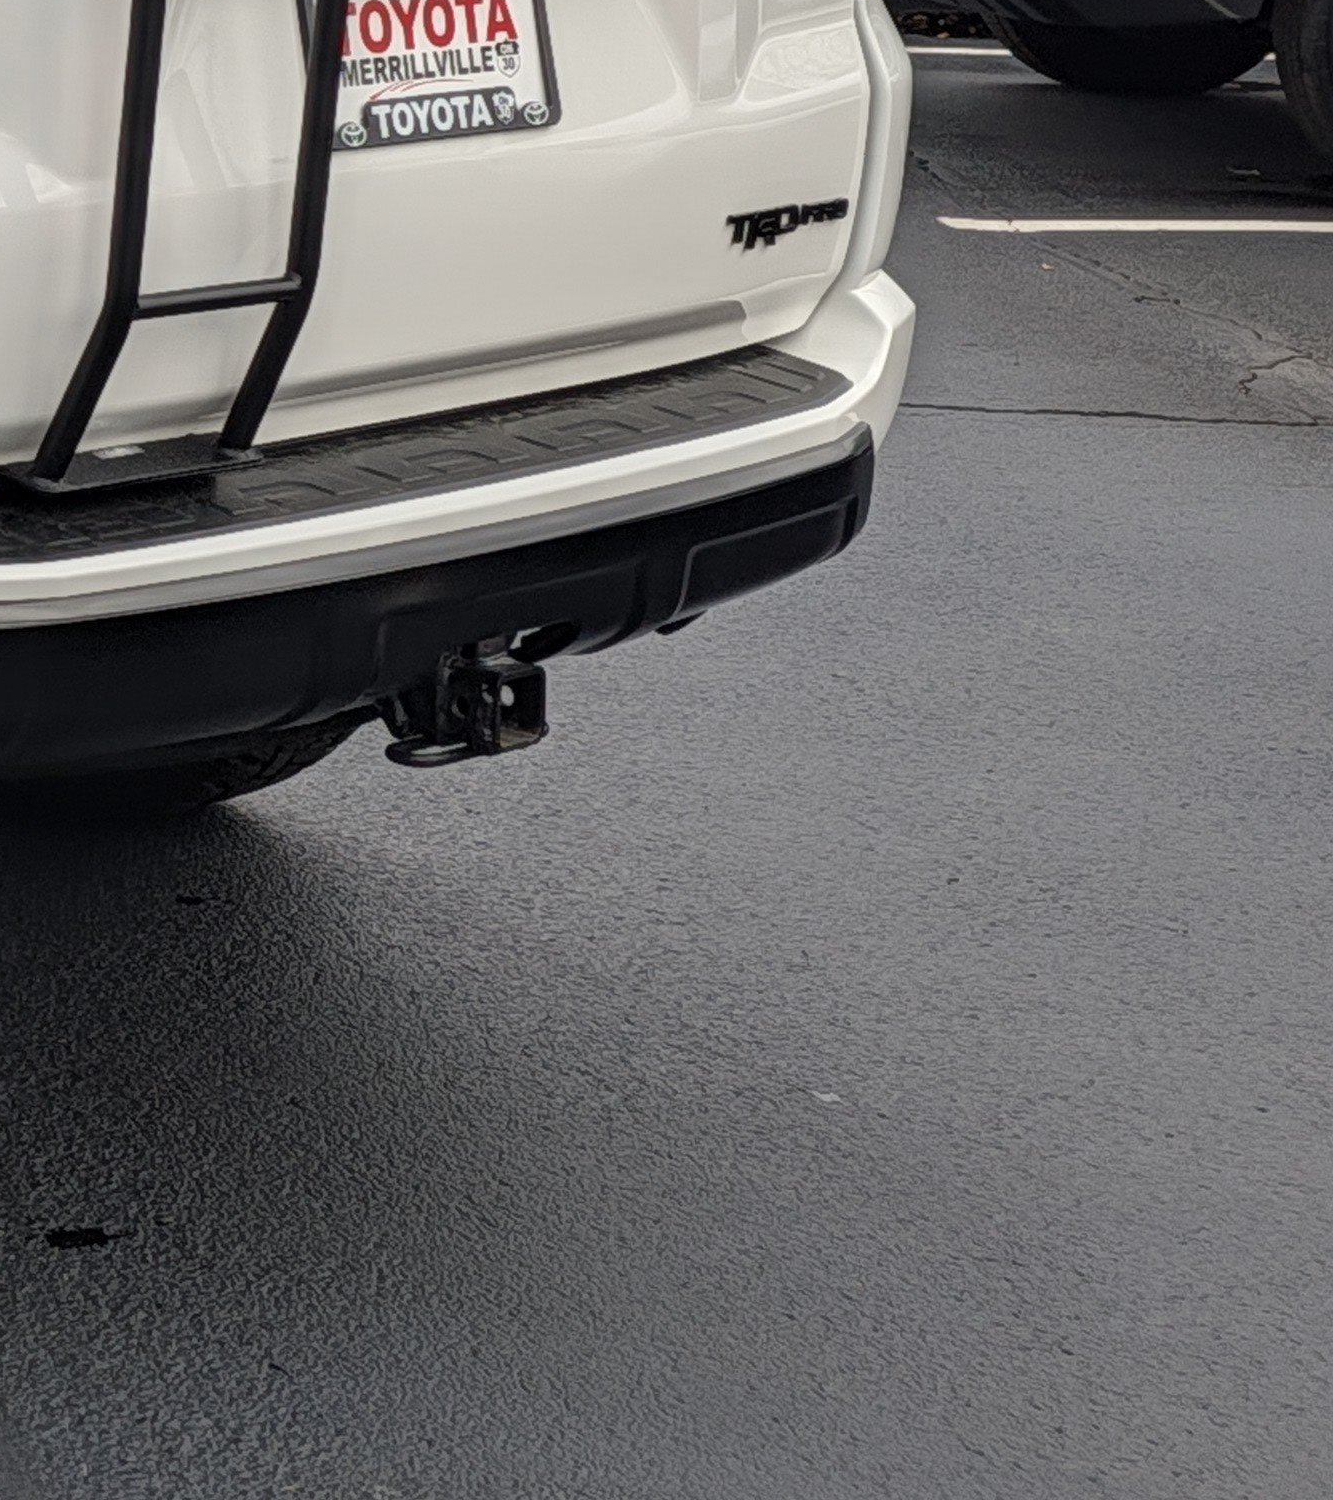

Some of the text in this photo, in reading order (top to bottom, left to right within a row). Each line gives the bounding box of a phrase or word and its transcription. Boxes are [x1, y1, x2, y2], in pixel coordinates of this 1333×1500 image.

[341, 46, 495, 88] MERRILLVILLE
[371, 94, 494, 139] TOYOTA
[726, 204, 799, 251] TRD
